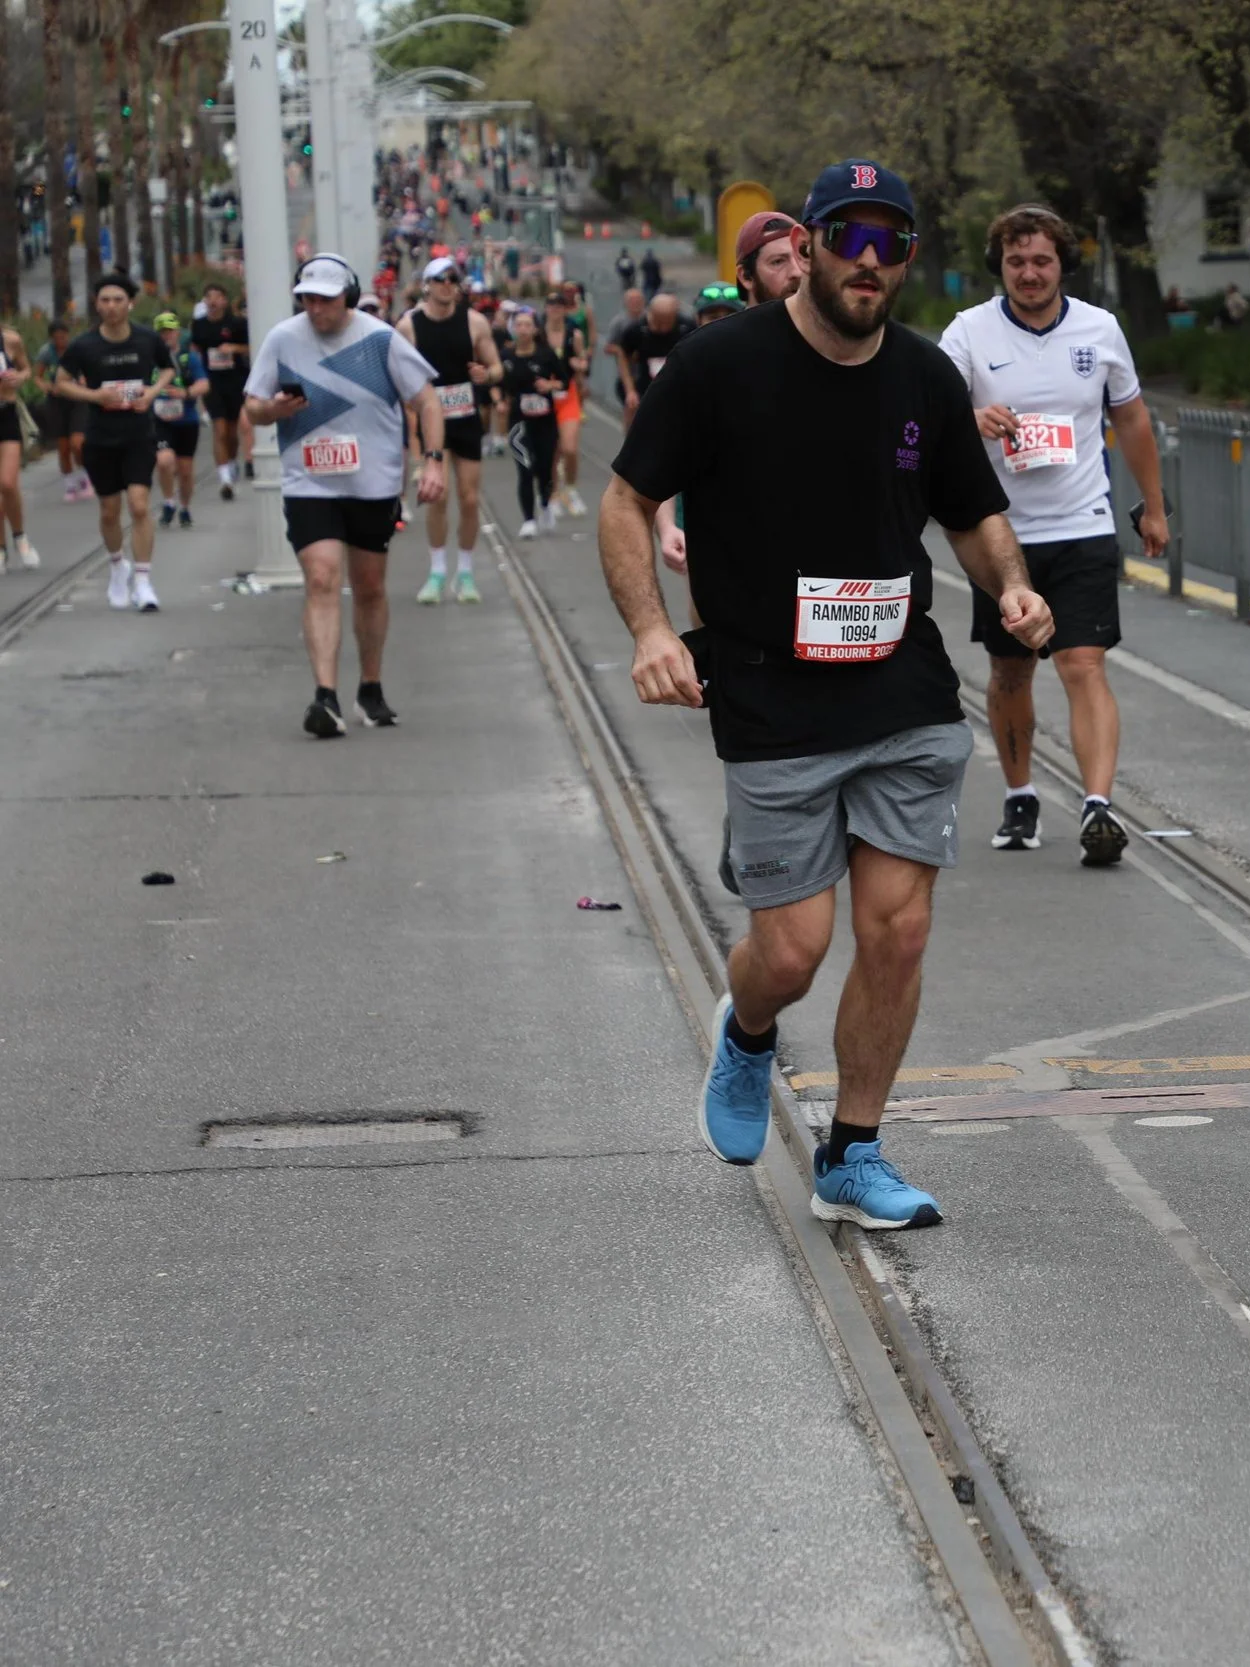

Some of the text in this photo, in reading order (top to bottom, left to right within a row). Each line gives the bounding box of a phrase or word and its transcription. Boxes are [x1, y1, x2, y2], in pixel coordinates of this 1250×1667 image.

[240, 20, 266, 40] 20
[249, 53, 262, 70] A
[851, 165, 877, 188] B
[812, 603, 900, 621] RAMMBO RUNS
[840, 625, 877, 642] 10994
[806, 644, 896, 659] MELBOURNE 2025
